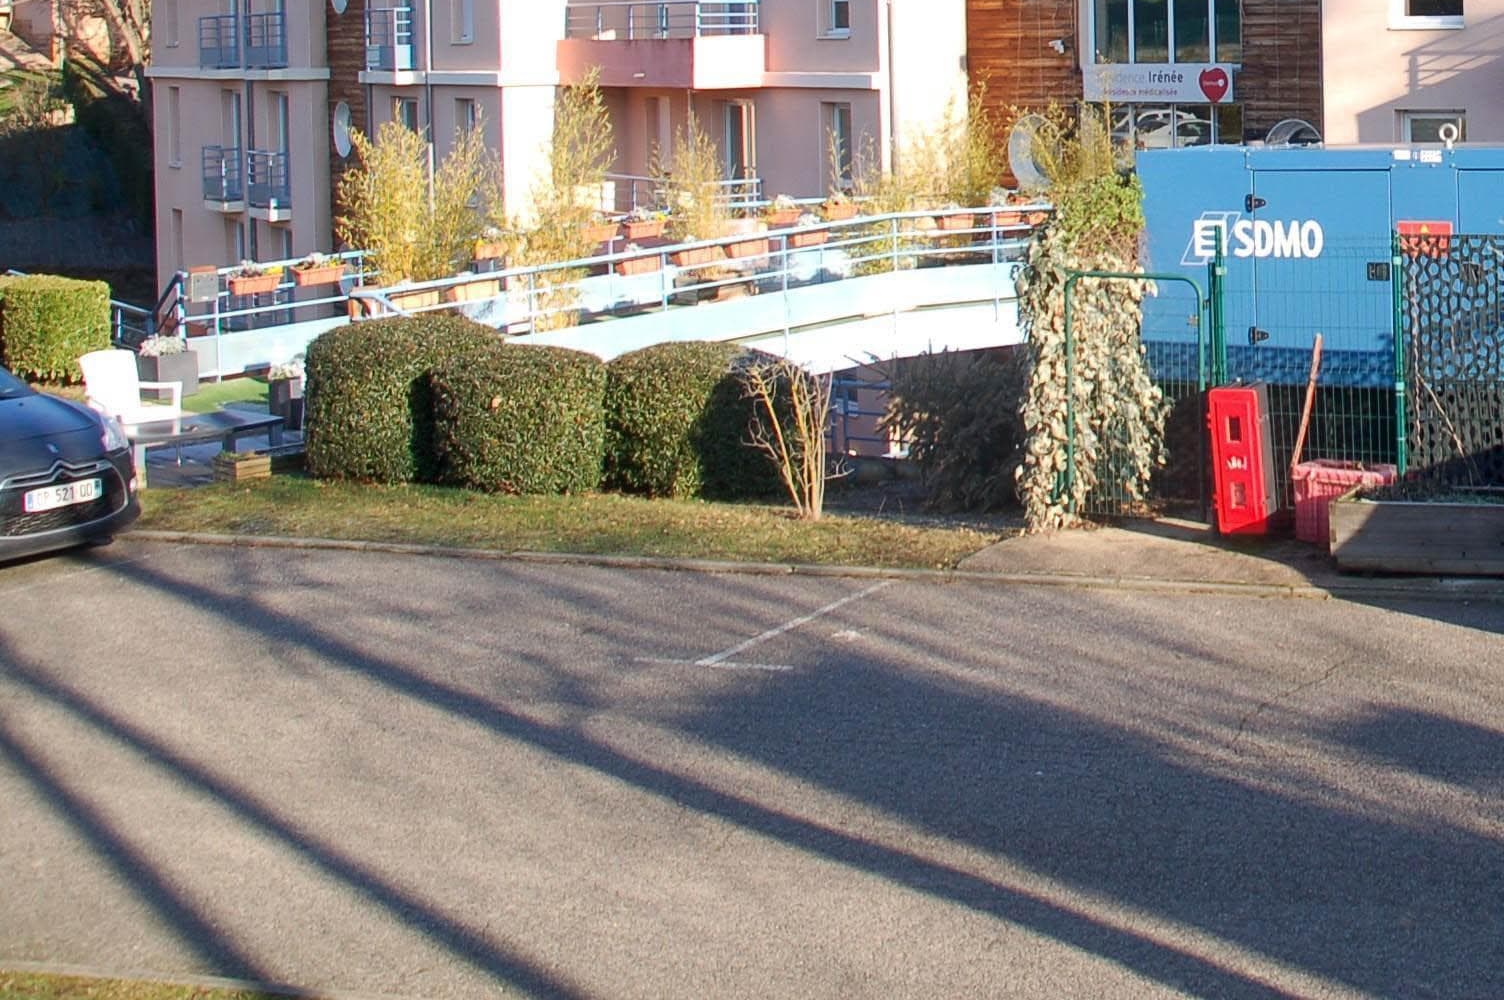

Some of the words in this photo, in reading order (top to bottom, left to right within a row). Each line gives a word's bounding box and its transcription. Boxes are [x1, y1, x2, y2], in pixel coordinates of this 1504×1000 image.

[1148, 70, 1184, 83] Irénée
[1233, 219, 1324, 258] SDMO
[56, 487, 74, 502] 521
